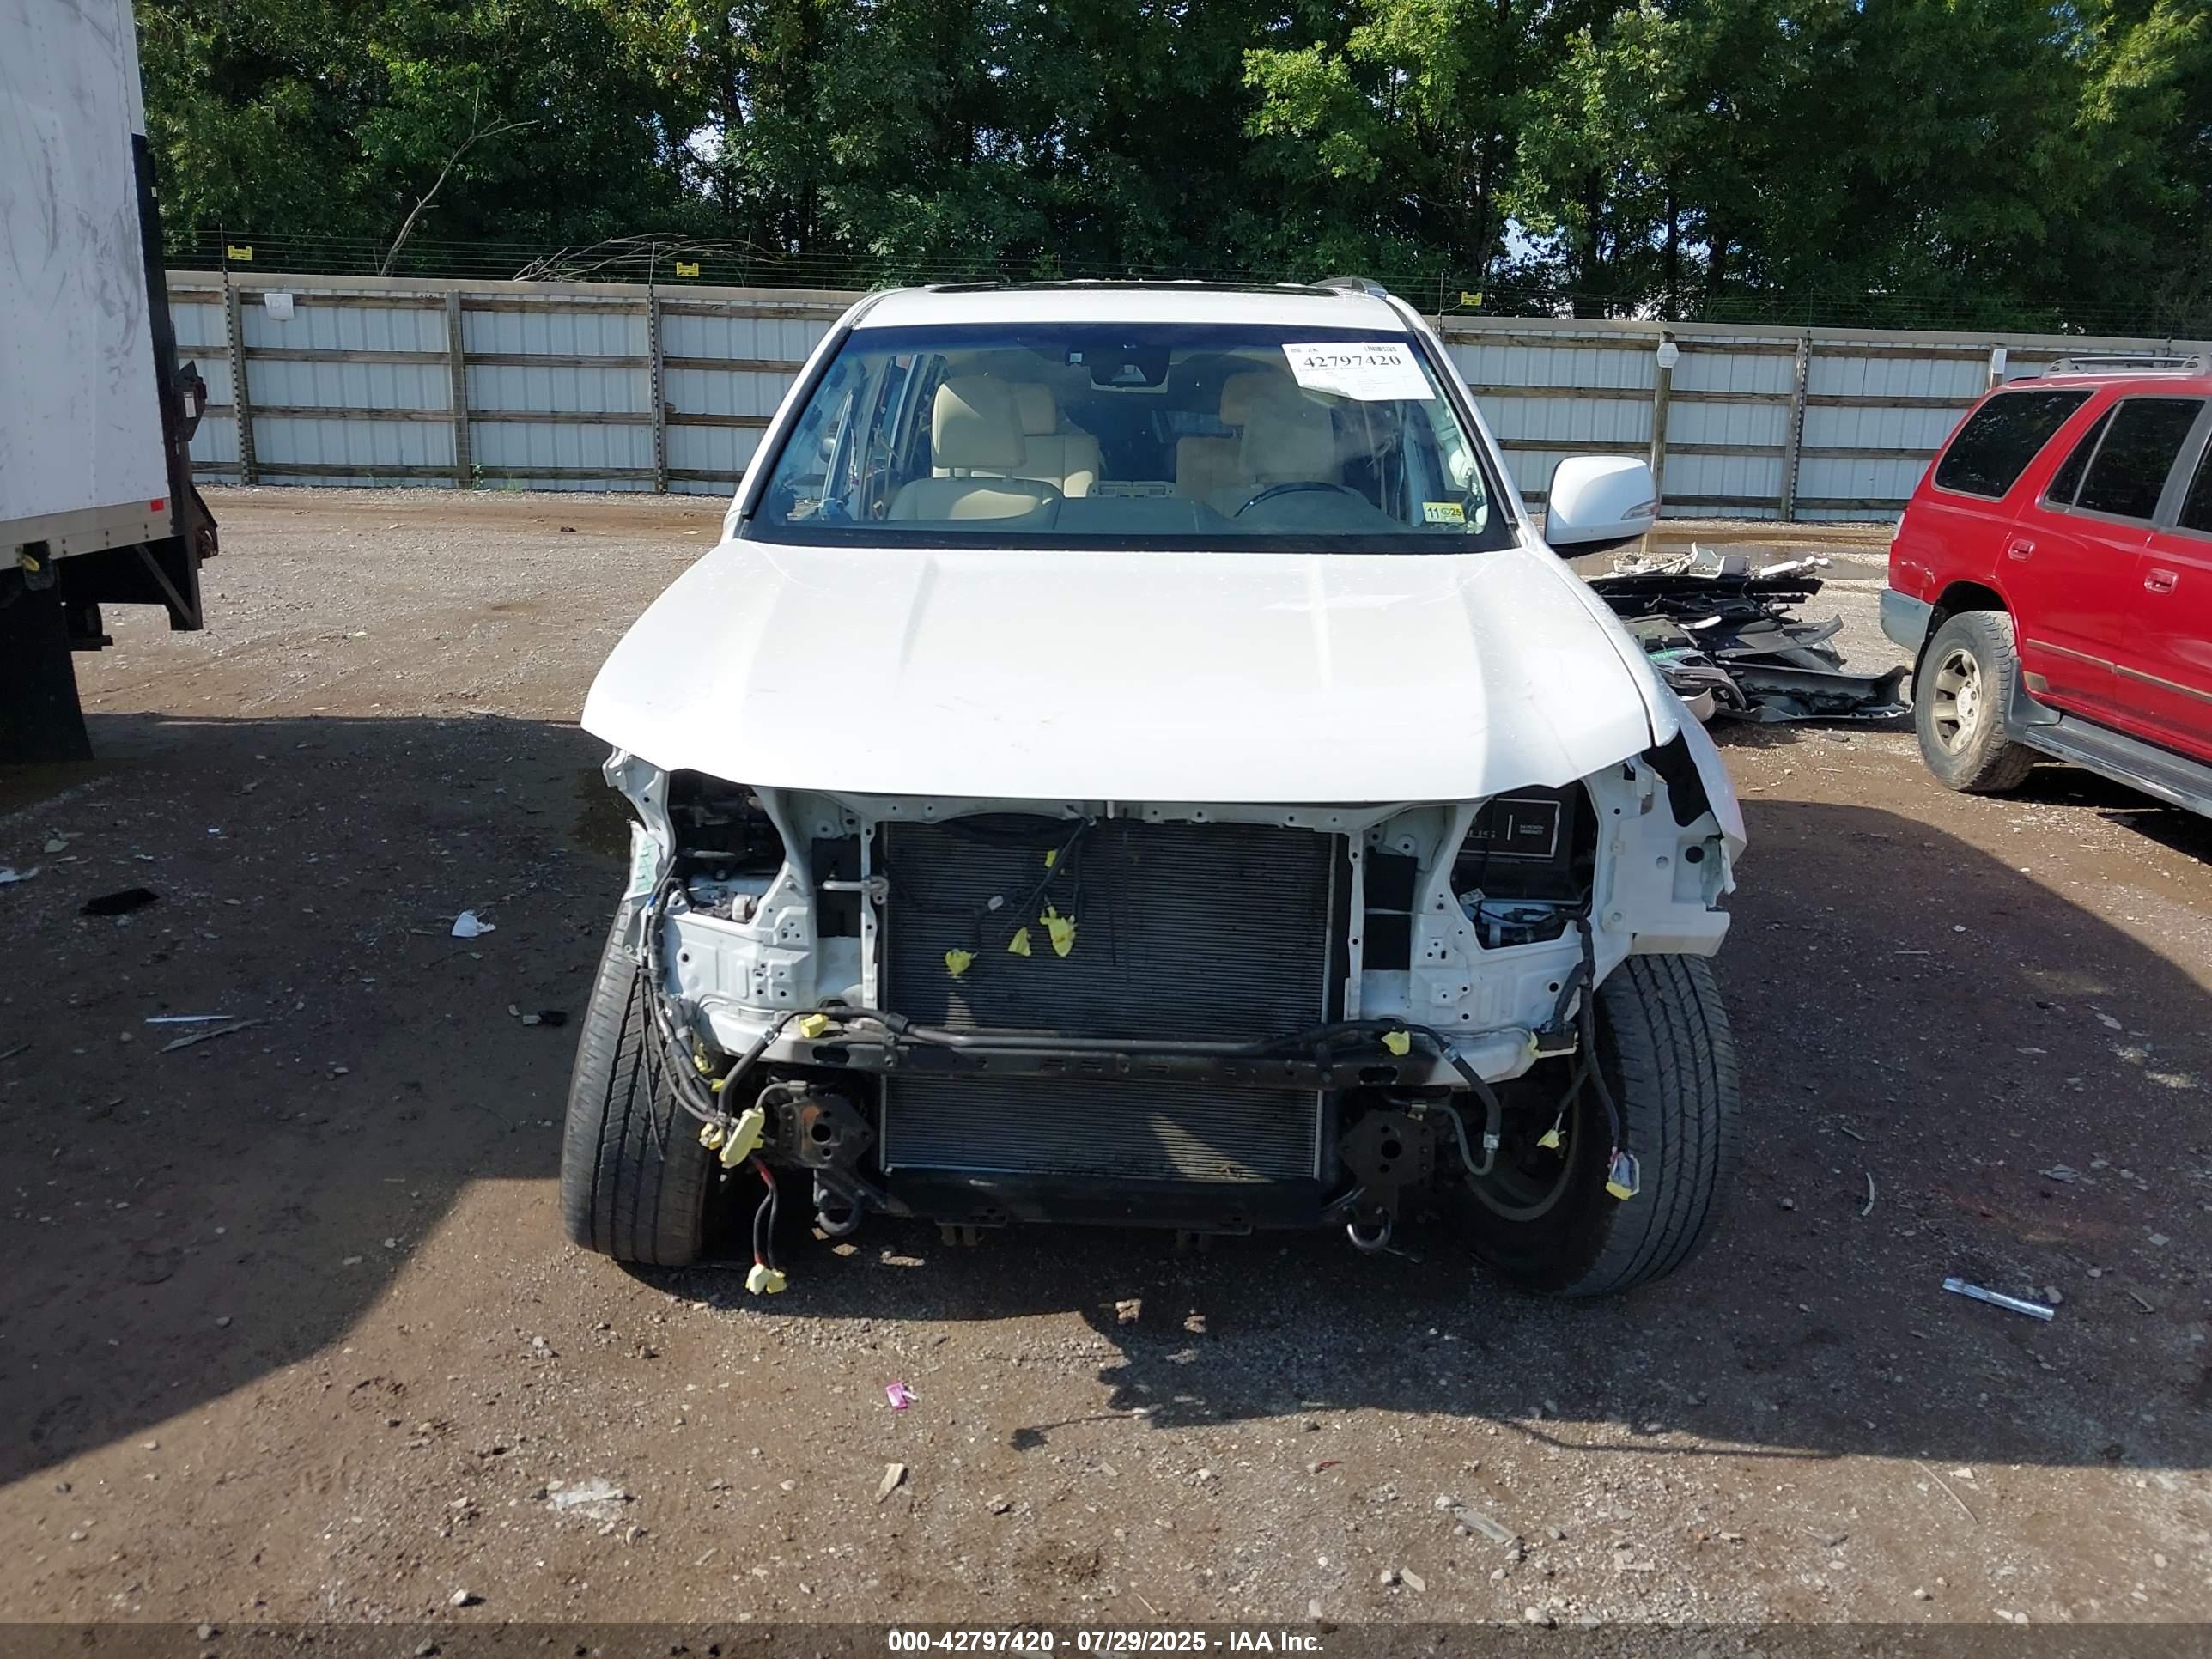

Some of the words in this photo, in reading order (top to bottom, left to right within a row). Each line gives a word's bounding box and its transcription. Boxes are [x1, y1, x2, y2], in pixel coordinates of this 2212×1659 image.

[1304, 355, 1401, 368] 42797420
[1428, 507, 1439, 519] 11
[1449, 507, 1462, 517] 25
